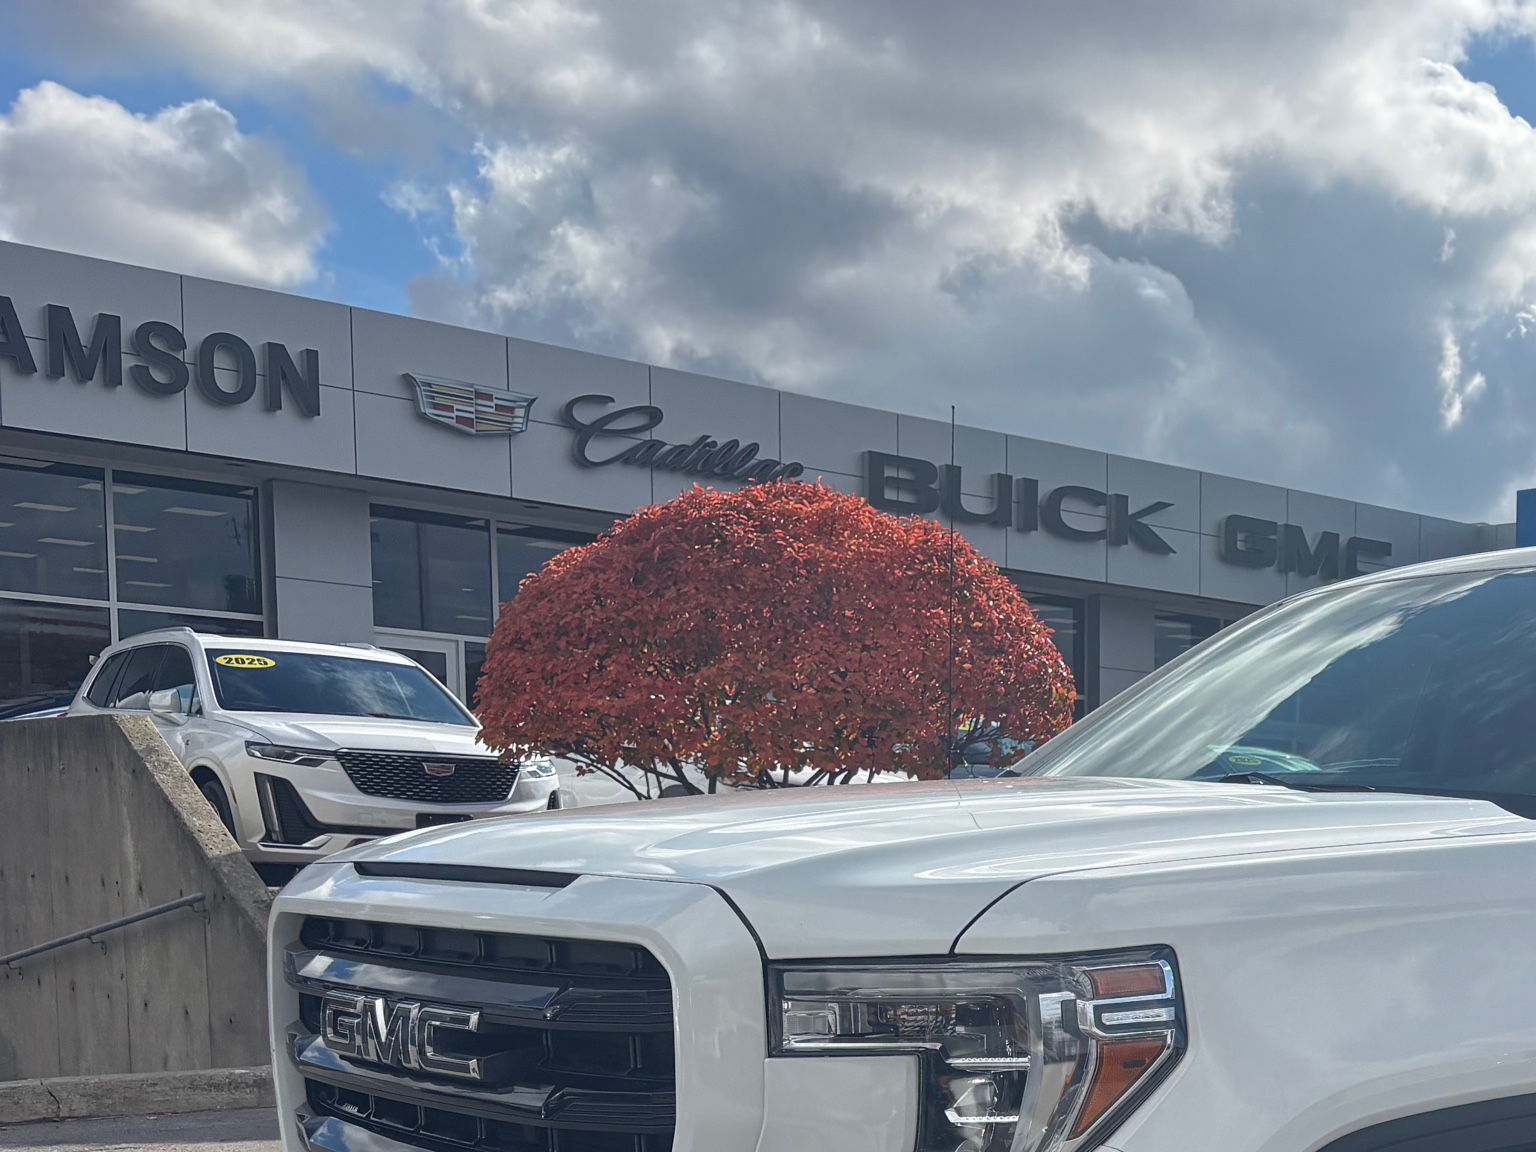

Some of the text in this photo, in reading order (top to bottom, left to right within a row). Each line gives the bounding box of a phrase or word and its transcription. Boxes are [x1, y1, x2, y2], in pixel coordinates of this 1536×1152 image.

[560, 394, 804, 484] Cadillac
[862, 450, 1177, 554] BUICK
[1219, 514, 1392, 579] GMC
[223, 657, 269, 666] 2025
[320, 990, 482, 1079] GMC
